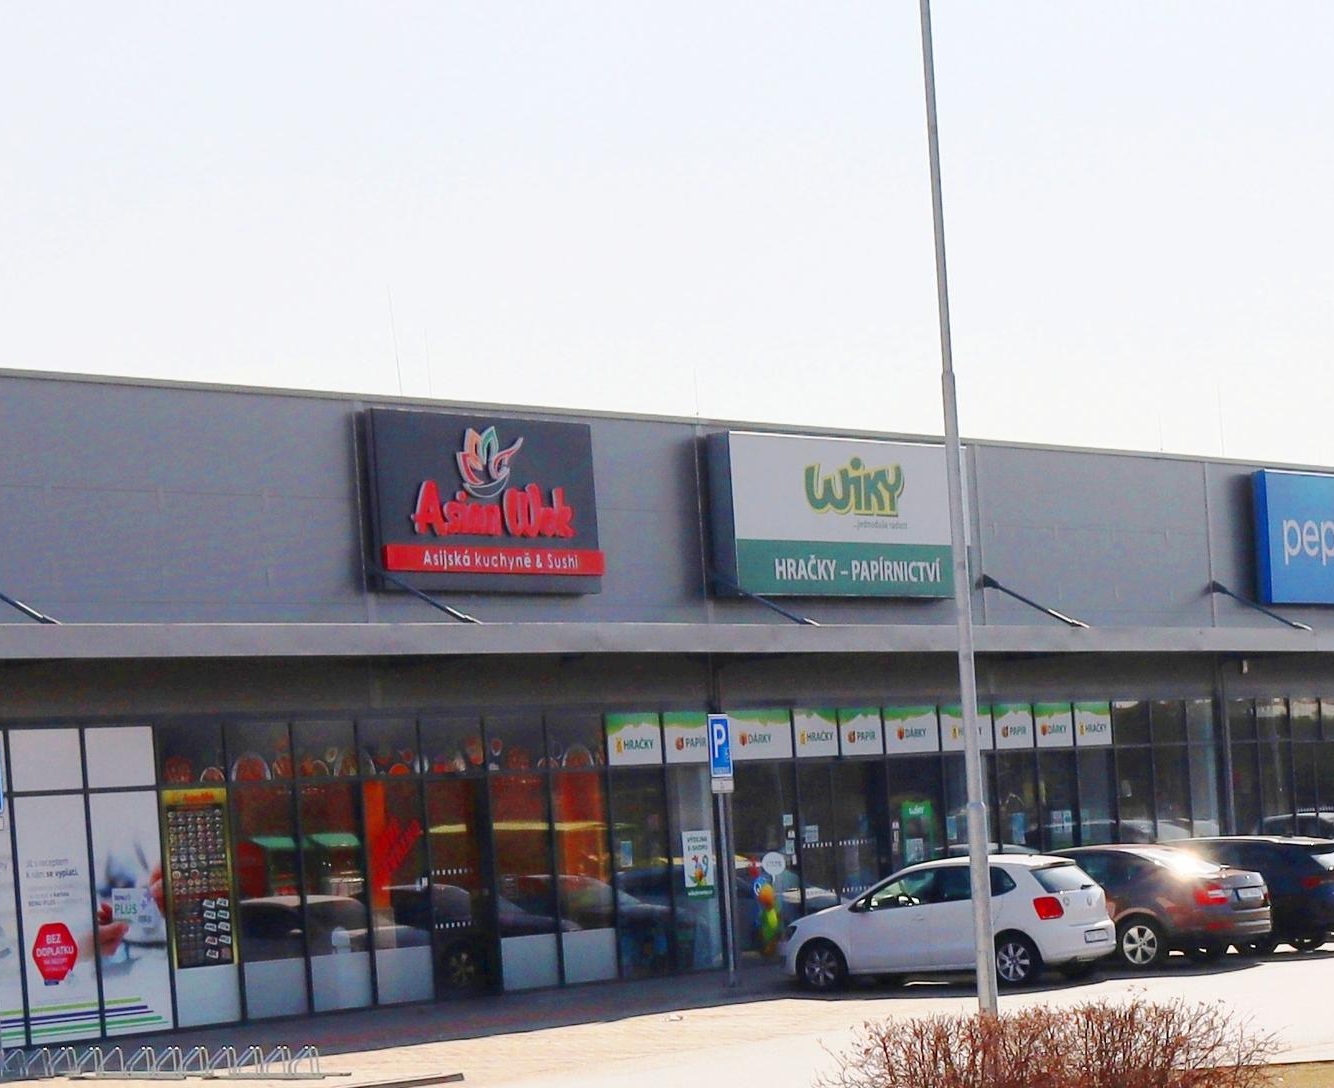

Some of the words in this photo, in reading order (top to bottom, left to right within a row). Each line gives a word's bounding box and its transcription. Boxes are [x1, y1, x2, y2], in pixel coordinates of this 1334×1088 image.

[410, 479, 503, 537] Asian
[423, 550, 471, 570] Asijská
[474, 551, 532, 571] kuchyně
[534, 554, 544, 568] &
[547, 554, 579, 570] Sushi
[774, 554, 837, 581] HRAČKY
[851, 555, 941, 583] PAPÍRNICTVÍ
[748, 732, 772, 744] DÁRKY
[806, 730, 834, 742] HRAČKY
[904, 727, 926, 739] DÁRKY
[623, 737, 654, 750] HRAČKY
[713, 723, 726, 758] P
[114, 903, 137, 915] PLUS
[46, 933, 62, 945] BEZ
[36, 945, 75, 958] DOPLATKU
